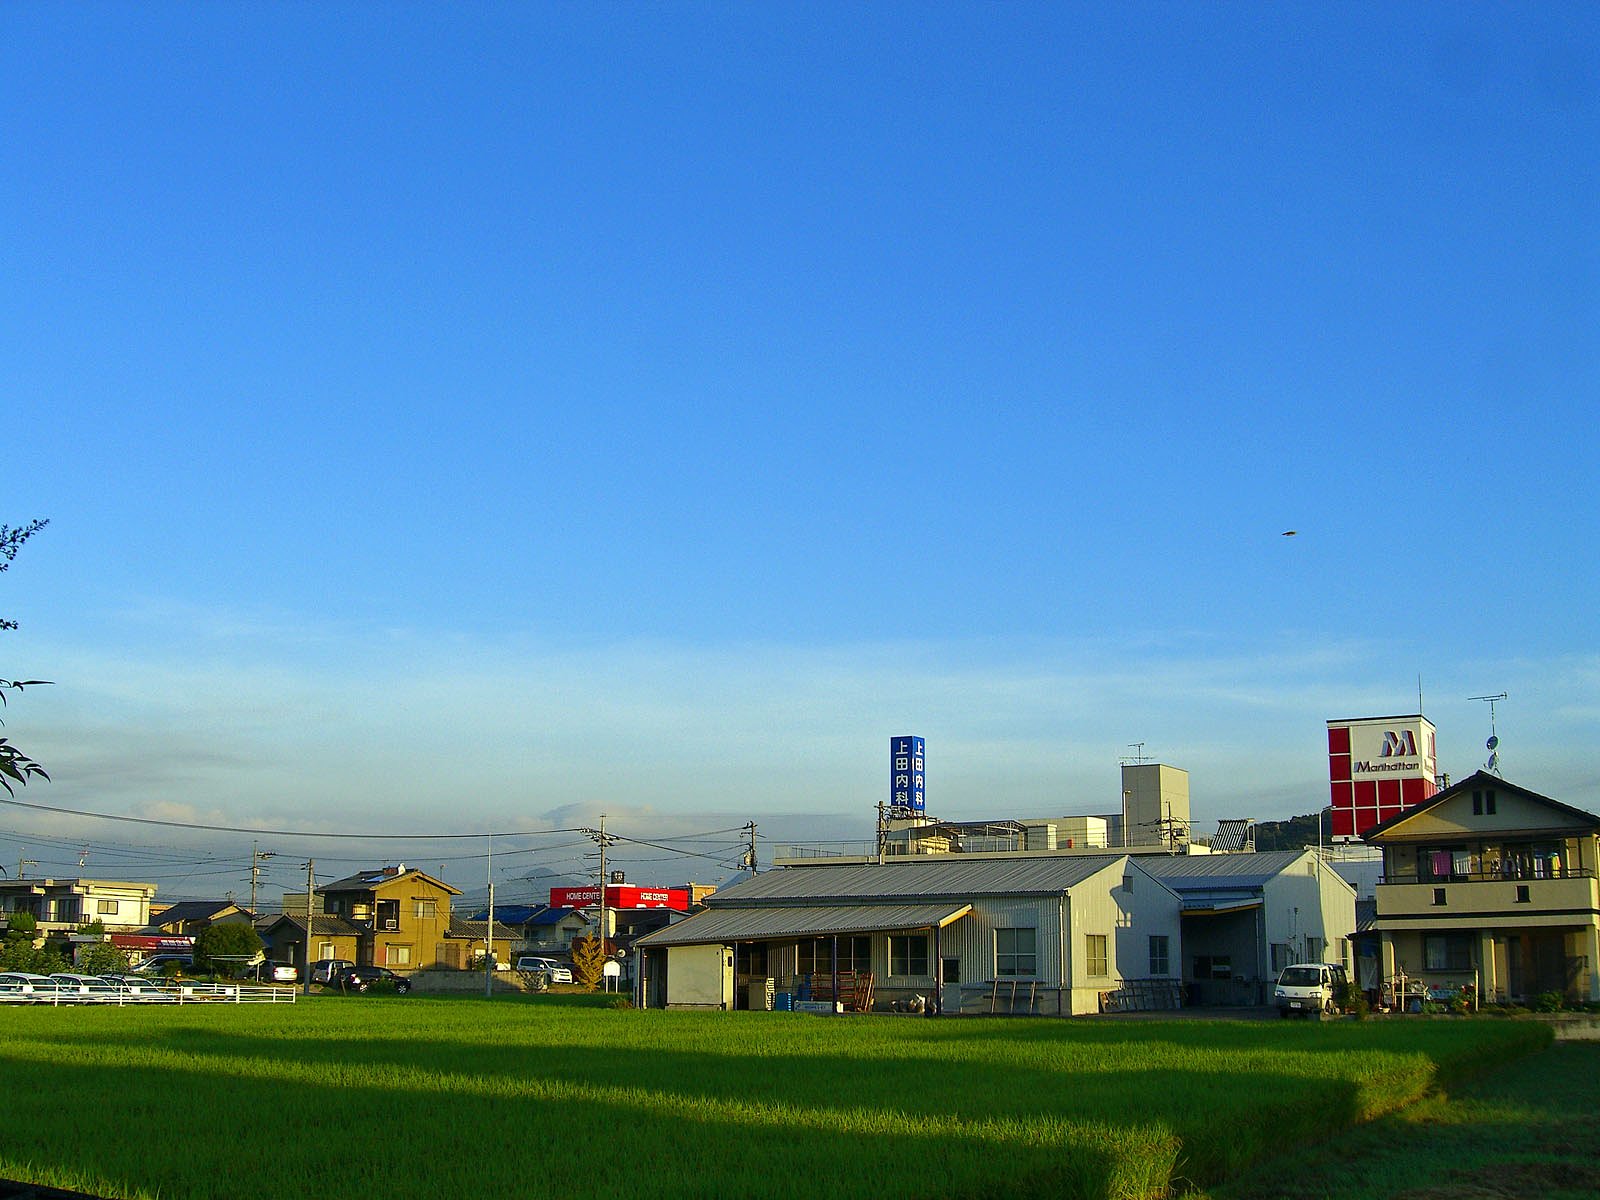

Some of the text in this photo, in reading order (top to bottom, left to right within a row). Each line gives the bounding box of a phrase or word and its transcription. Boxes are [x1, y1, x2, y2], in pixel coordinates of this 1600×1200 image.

[895, 740, 909, 805] 上田内科
[1353, 760, 1420, 773] Manhattan
[915, 741, 924, 806] 上田内科
[566, 892, 602, 900] HOME CENTE
[640, 892, 669, 901] HOME CENTER
